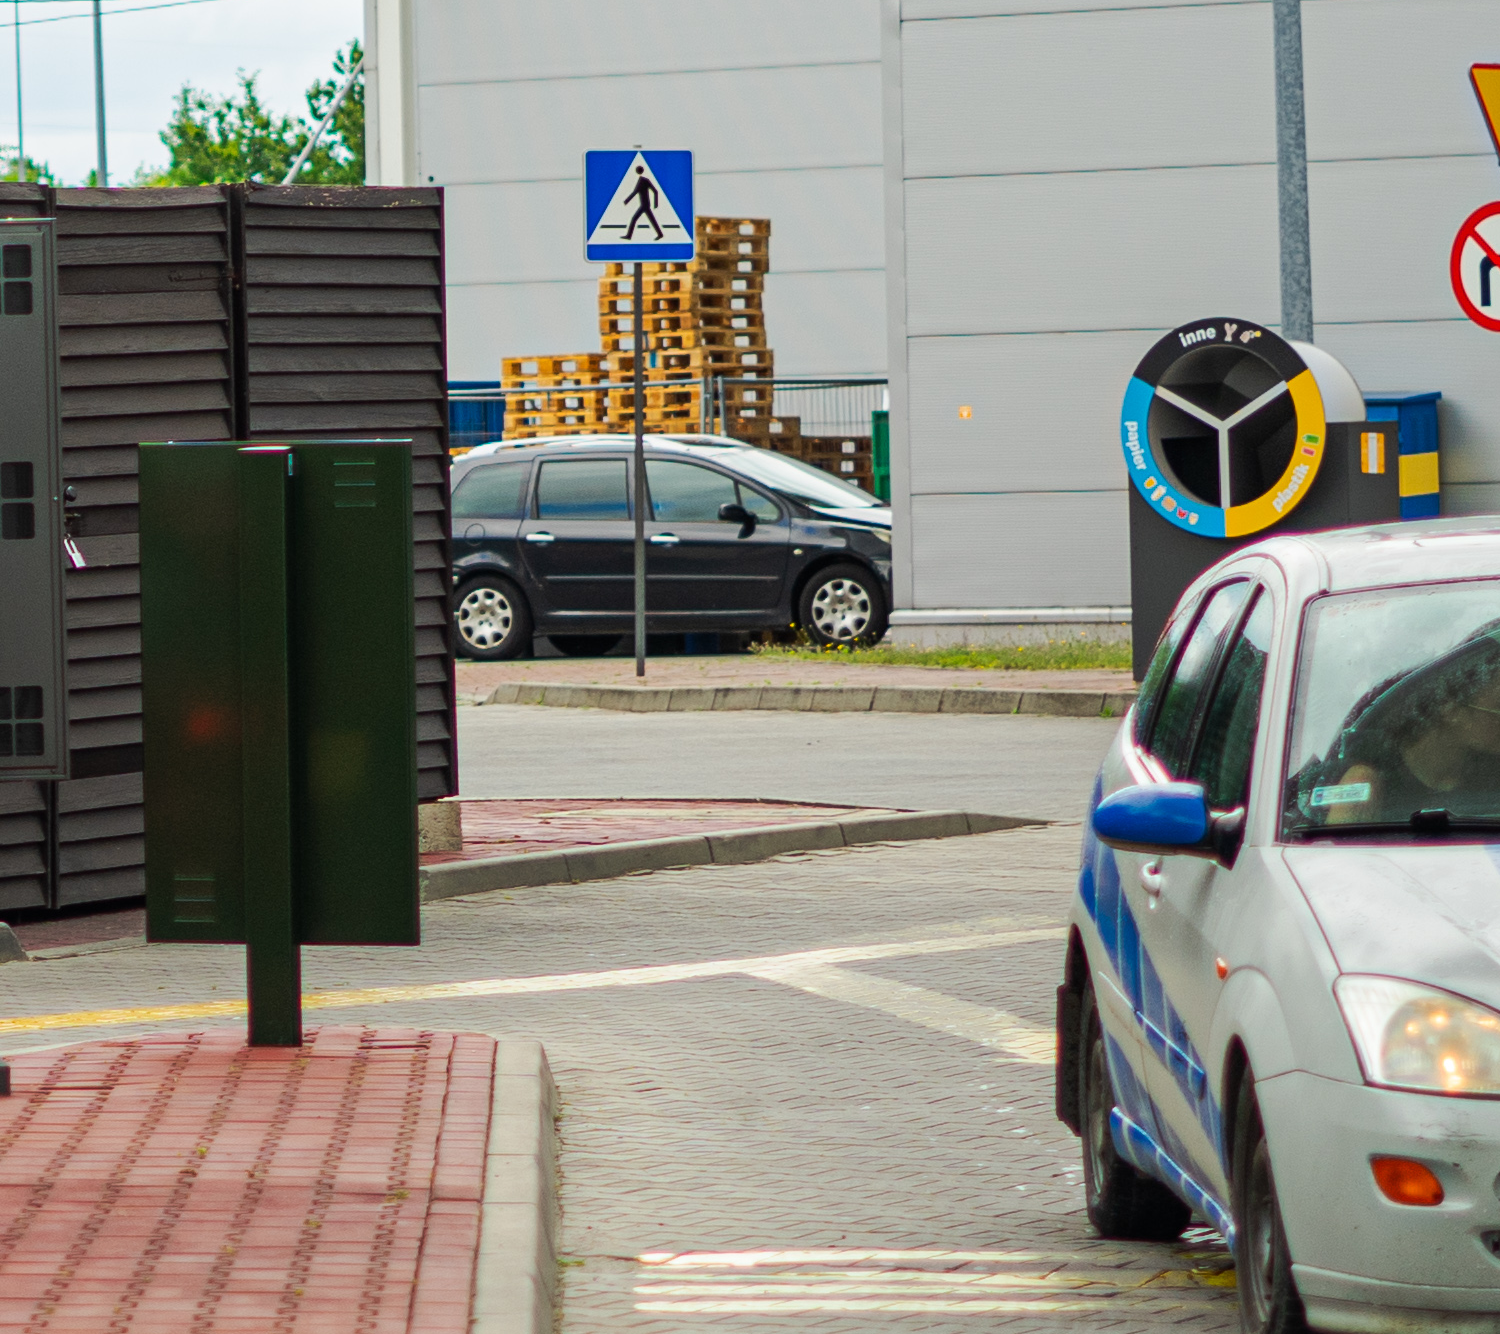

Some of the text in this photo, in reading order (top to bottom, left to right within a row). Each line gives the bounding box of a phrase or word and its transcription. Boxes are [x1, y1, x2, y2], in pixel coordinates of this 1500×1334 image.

[1178, 327, 1216, 348] inne
[1124, 420, 1147, 471] papier
[1272, 463, 1310, 513] plastik
